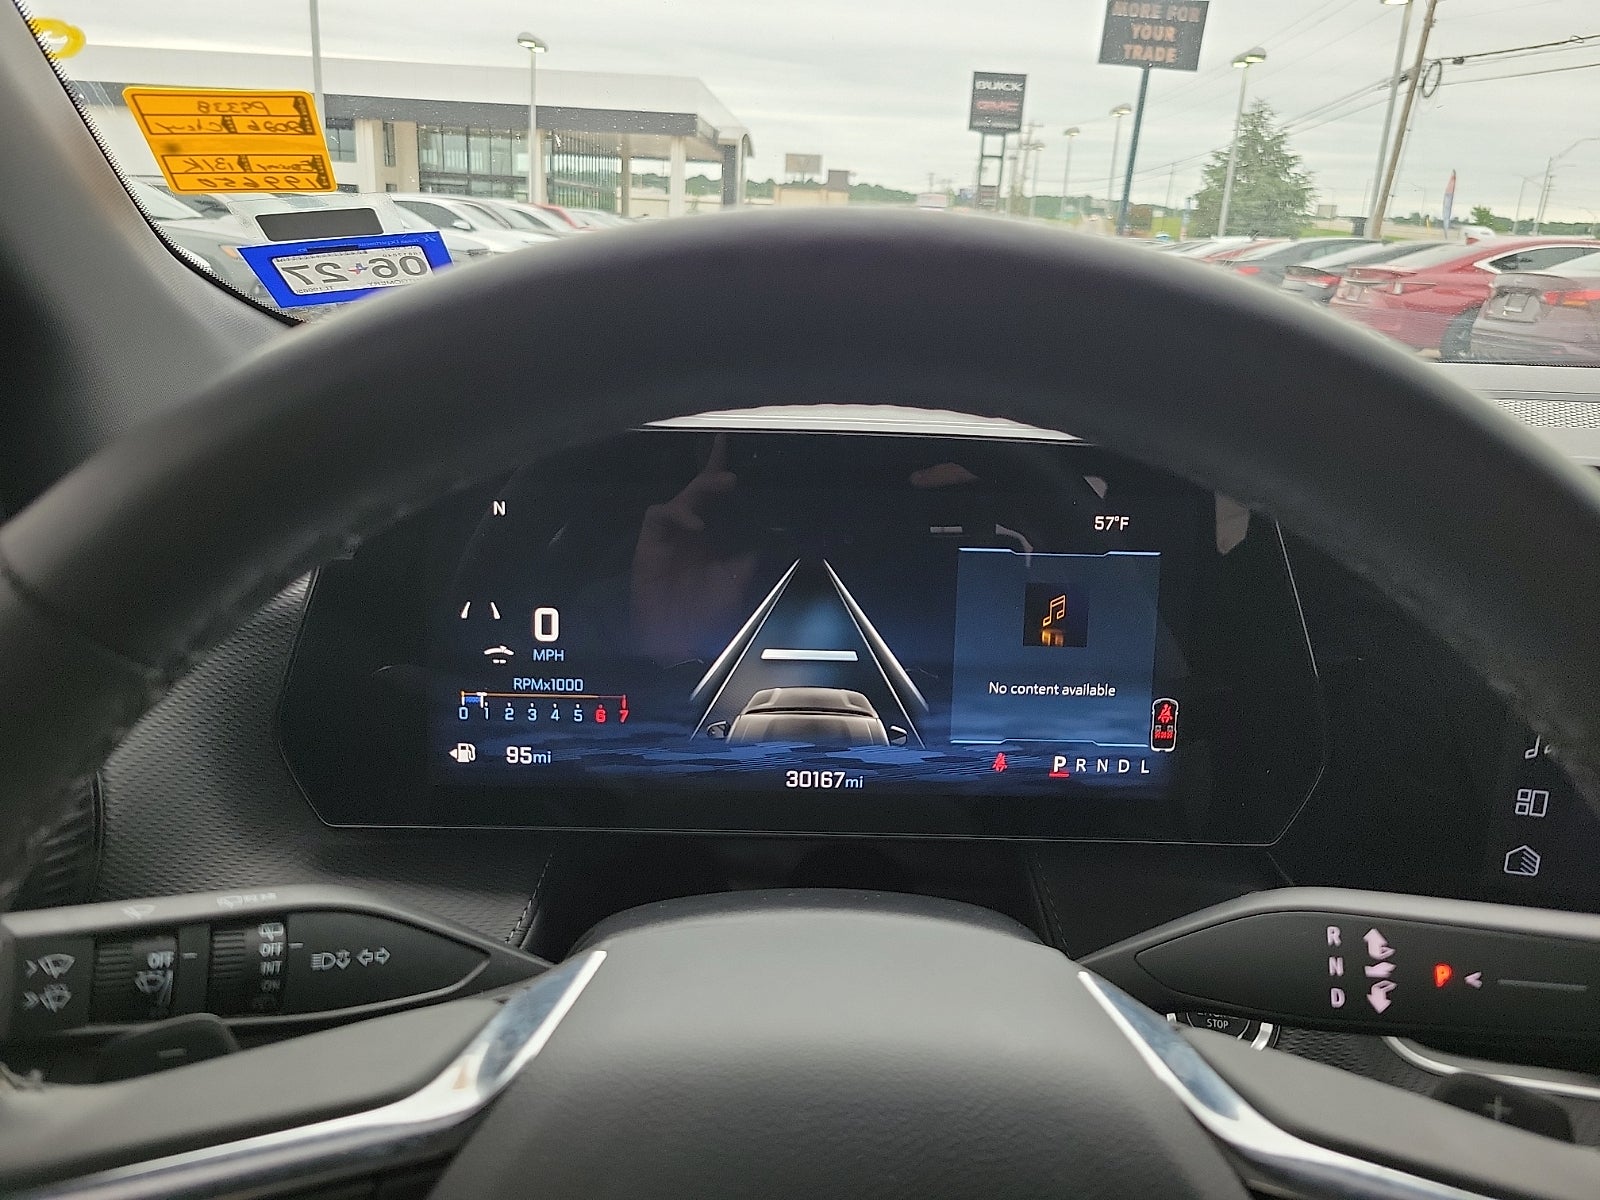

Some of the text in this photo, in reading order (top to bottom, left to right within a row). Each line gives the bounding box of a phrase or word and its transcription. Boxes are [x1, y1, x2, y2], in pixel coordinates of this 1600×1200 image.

[1112, 1, 1200, 22] MORE FOR
[1131, 23, 1177, 42] YOUR
[1123, 43, 1177, 63] TRADE
[975, 80, 1024, 92] BUICK
[493, 501, 506, 516] N
[1094, 515, 1129, 530] 57°F
[534, 607, 559, 642] 0
[533, 649, 564, 662] MPH
[513, 678, 584, 691] RPMx1000
[989, 682, 1116, 697] No content available
[458, 707, 629, 723] 0 1 2 3 4 5 6 7
[1053, 756, 1150, 773] P R N D L
[1326, 926, 1341, 946] R
[259, 942, 283, 957] OFF
[261, 961, 282, 975] INT
[1328, 957, 1344, 976] N
[1434, 963, 1452, 988] P
[1331, 987, 1346, 1008] D
[1207, 1019, 1229, 1029] STOP
